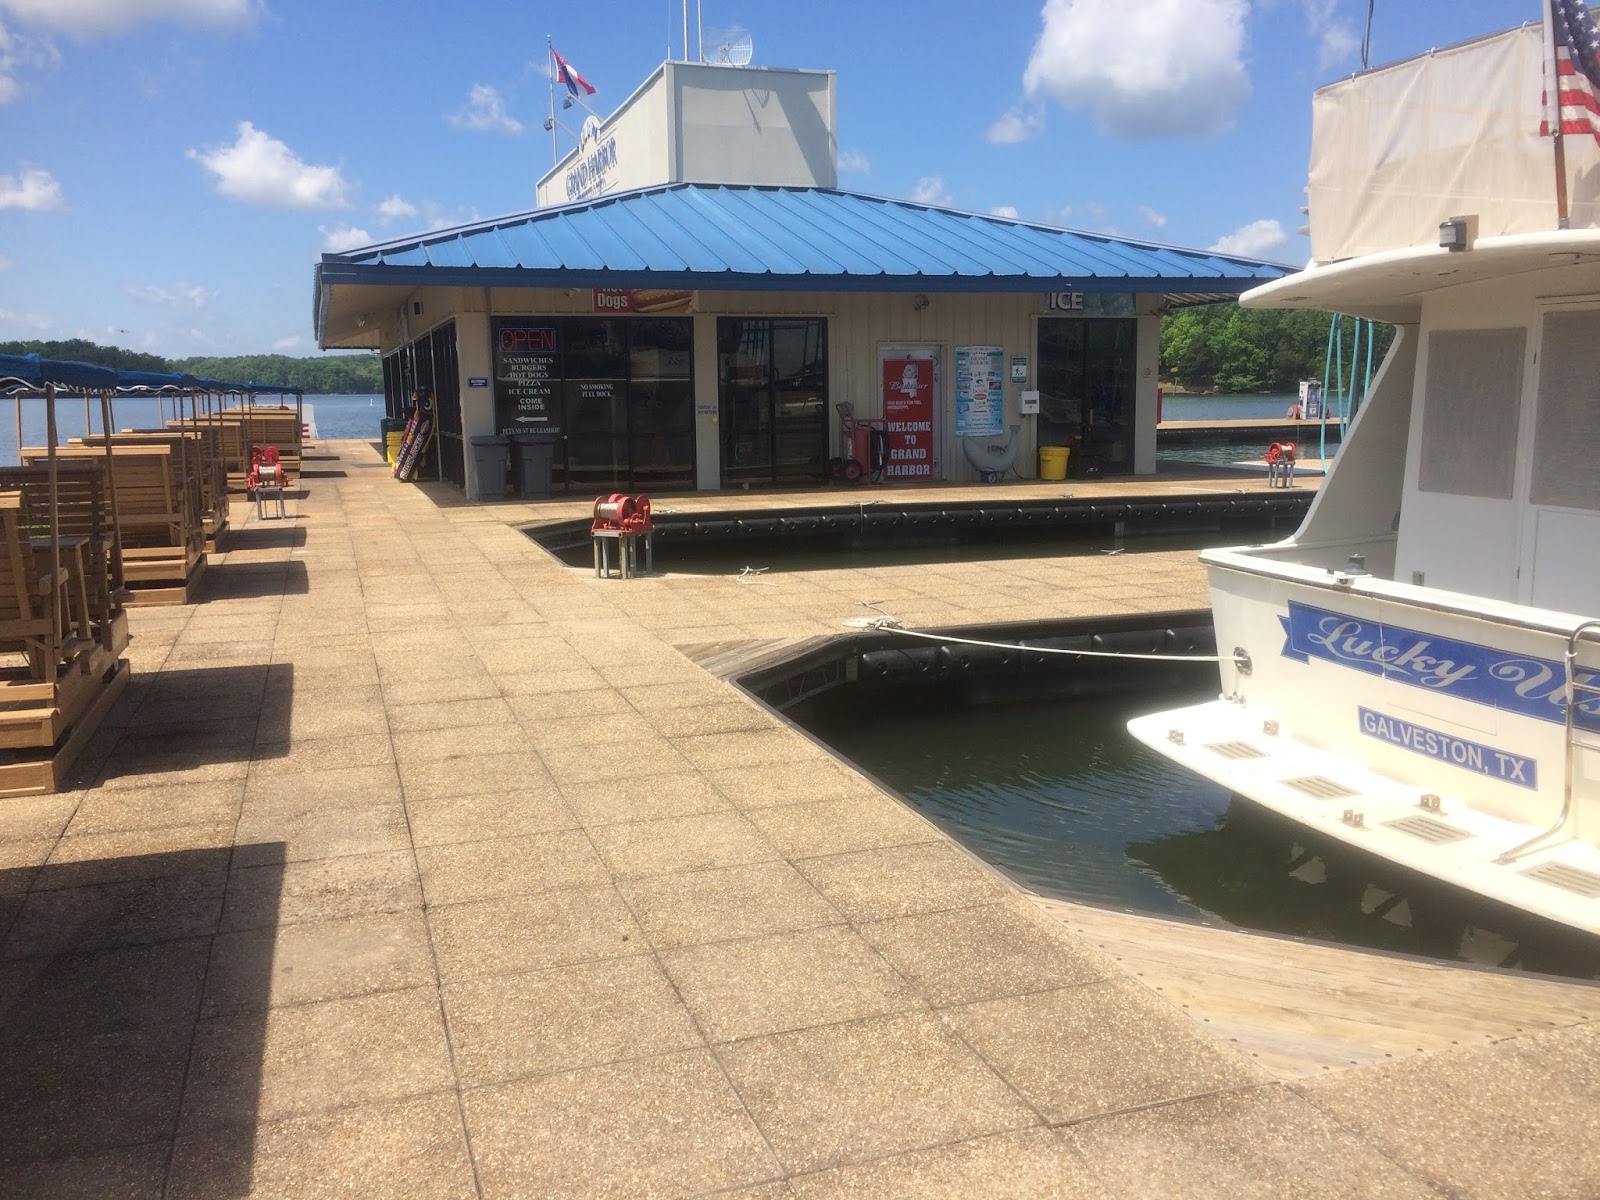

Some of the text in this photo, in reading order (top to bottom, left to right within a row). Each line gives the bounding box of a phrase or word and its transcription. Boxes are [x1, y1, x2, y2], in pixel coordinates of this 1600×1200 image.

[566, 162, 588, 200] GRAND
[587, 136, 618, 181] HARBOR
[597, 293, 628, 309] Dogs
[1051, 292, 1084, 309] ICE
[501, 330, 554, 350] OPEN
[887, 421, 931, 432] WELCOME
[904, 434, 917, 445] TO
[891, 448, 927, 459] GRAND
[887, 464, 931, 475] HARBOR
[1308, 616, 1478, 687] Lucky
[1363, 712, 1526, 782] GALVESTON, TX
